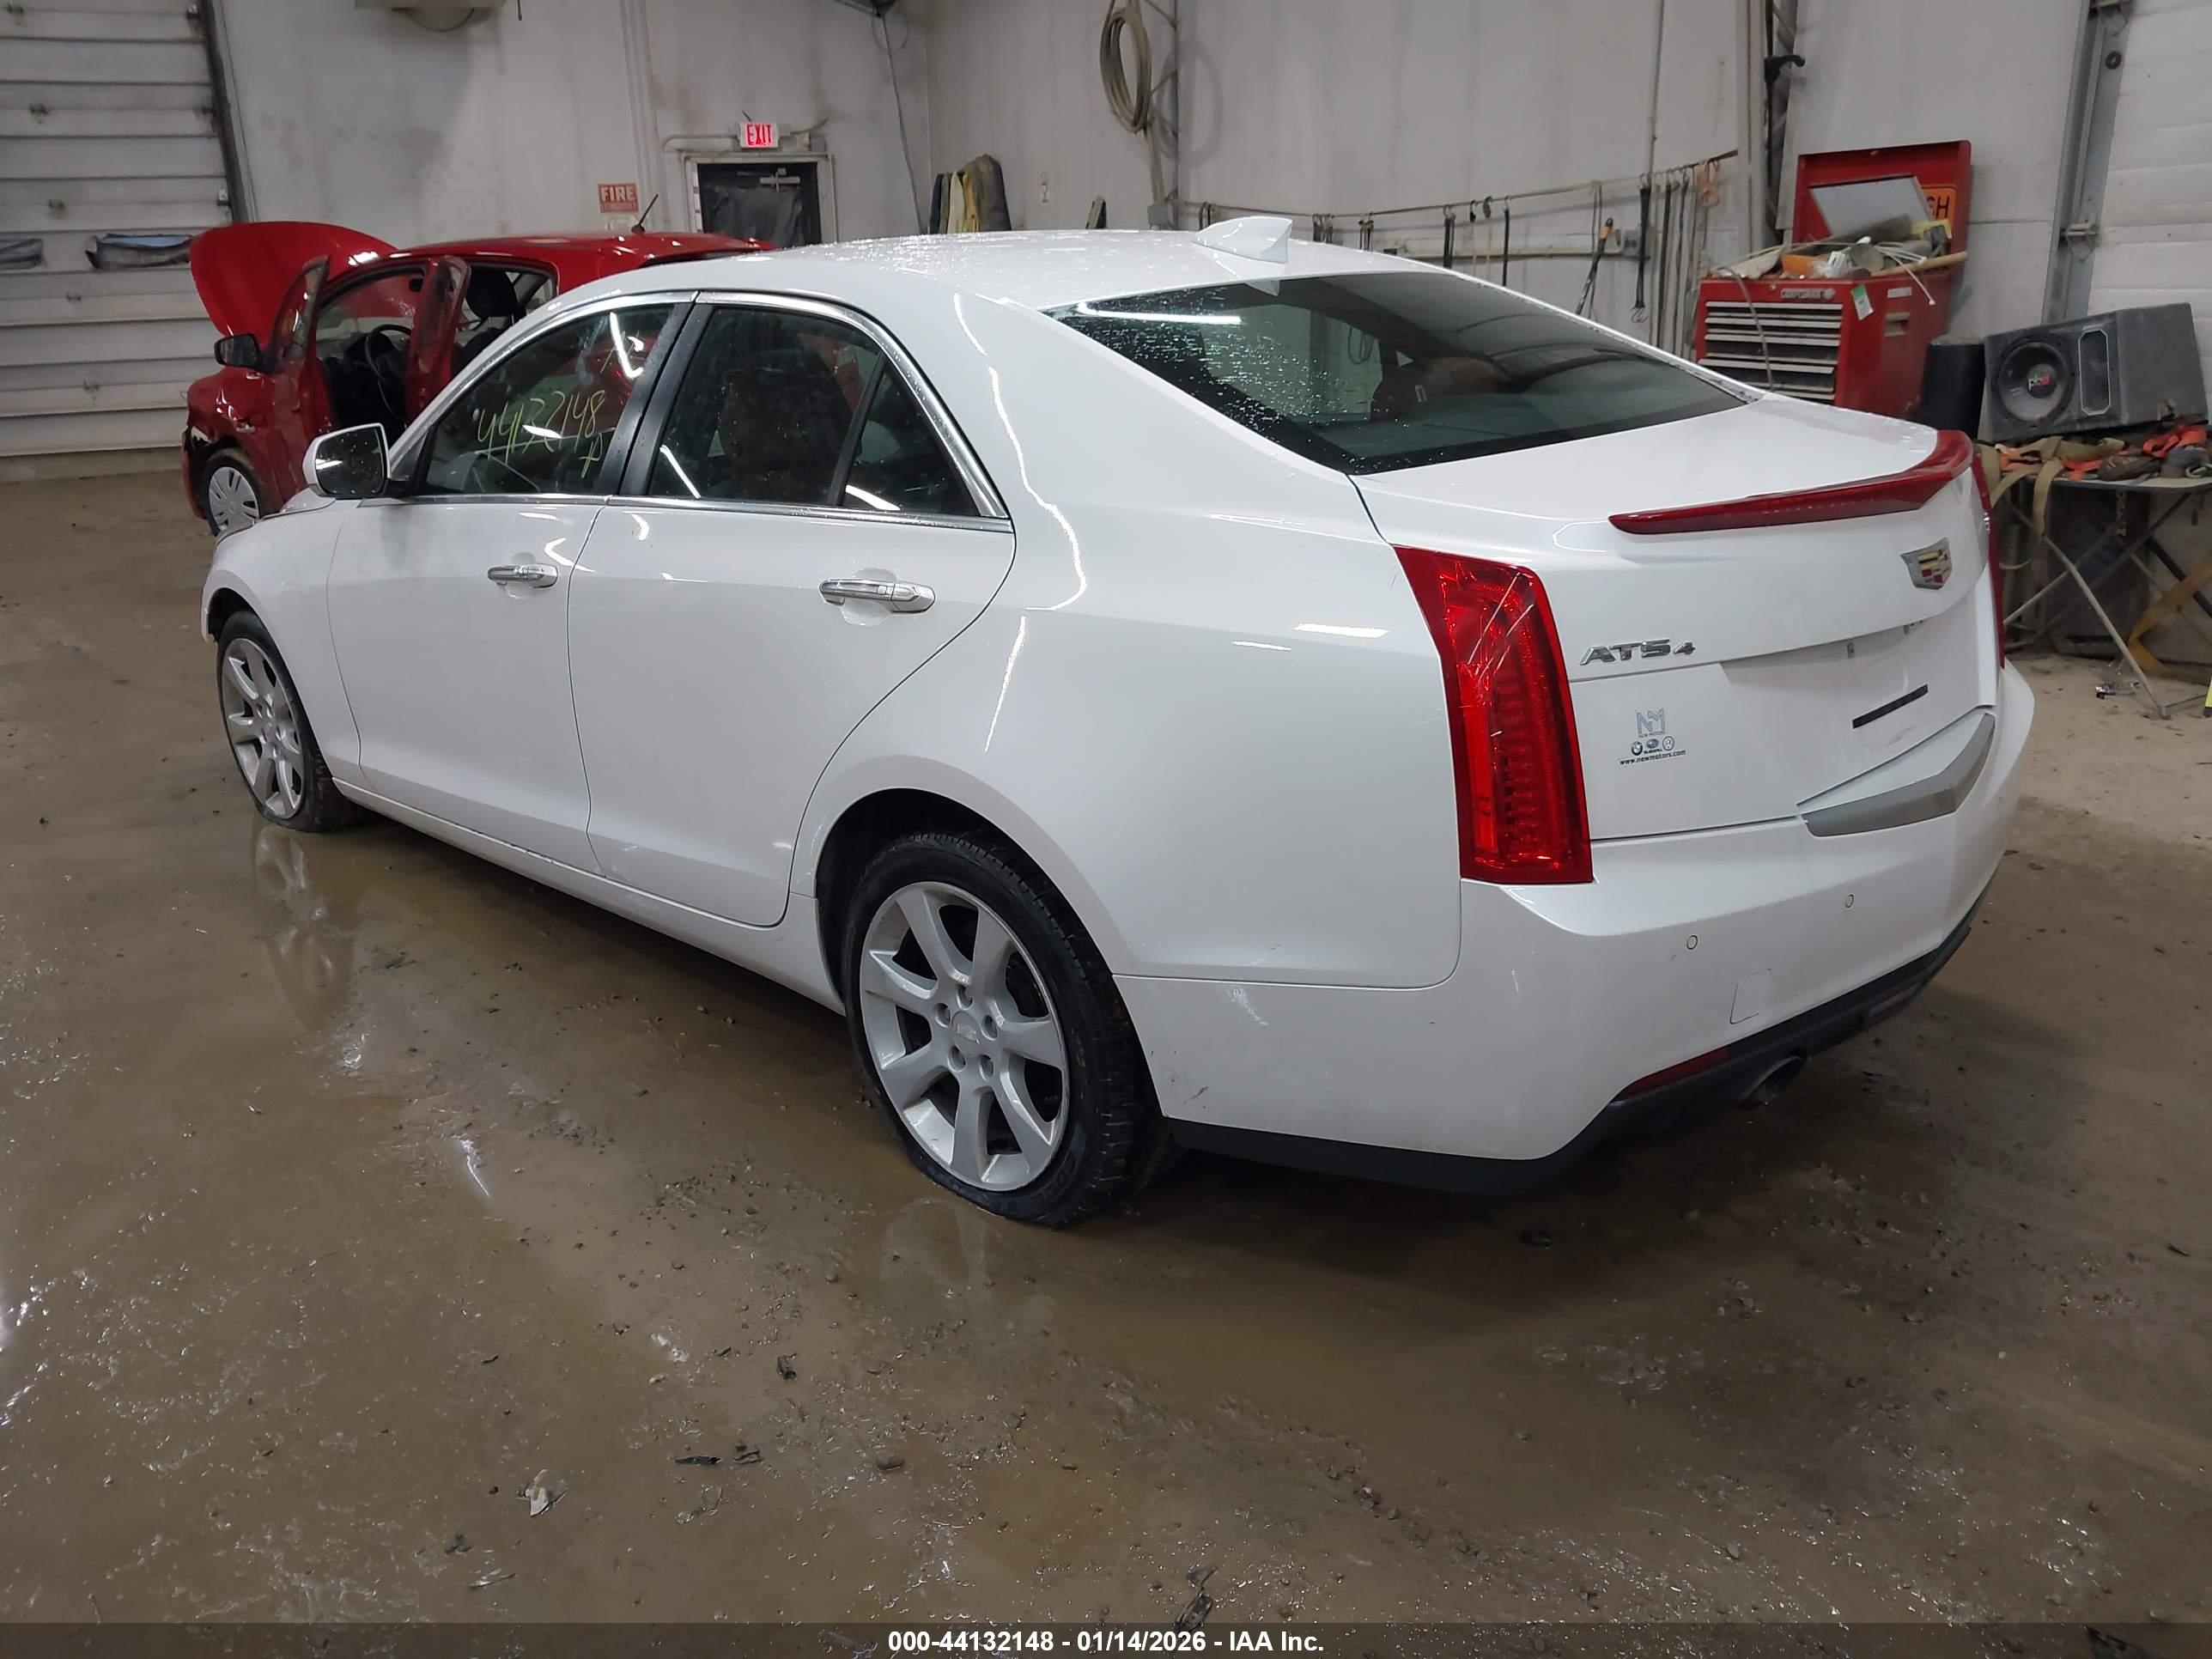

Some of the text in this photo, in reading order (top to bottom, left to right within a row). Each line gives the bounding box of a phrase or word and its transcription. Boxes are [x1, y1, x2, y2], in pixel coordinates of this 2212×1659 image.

[745, 124, 772, 146] EXIT
[601, 185, 635, 202] FIRE
[1620, 750, 1686, 765] www.newmotors.com
